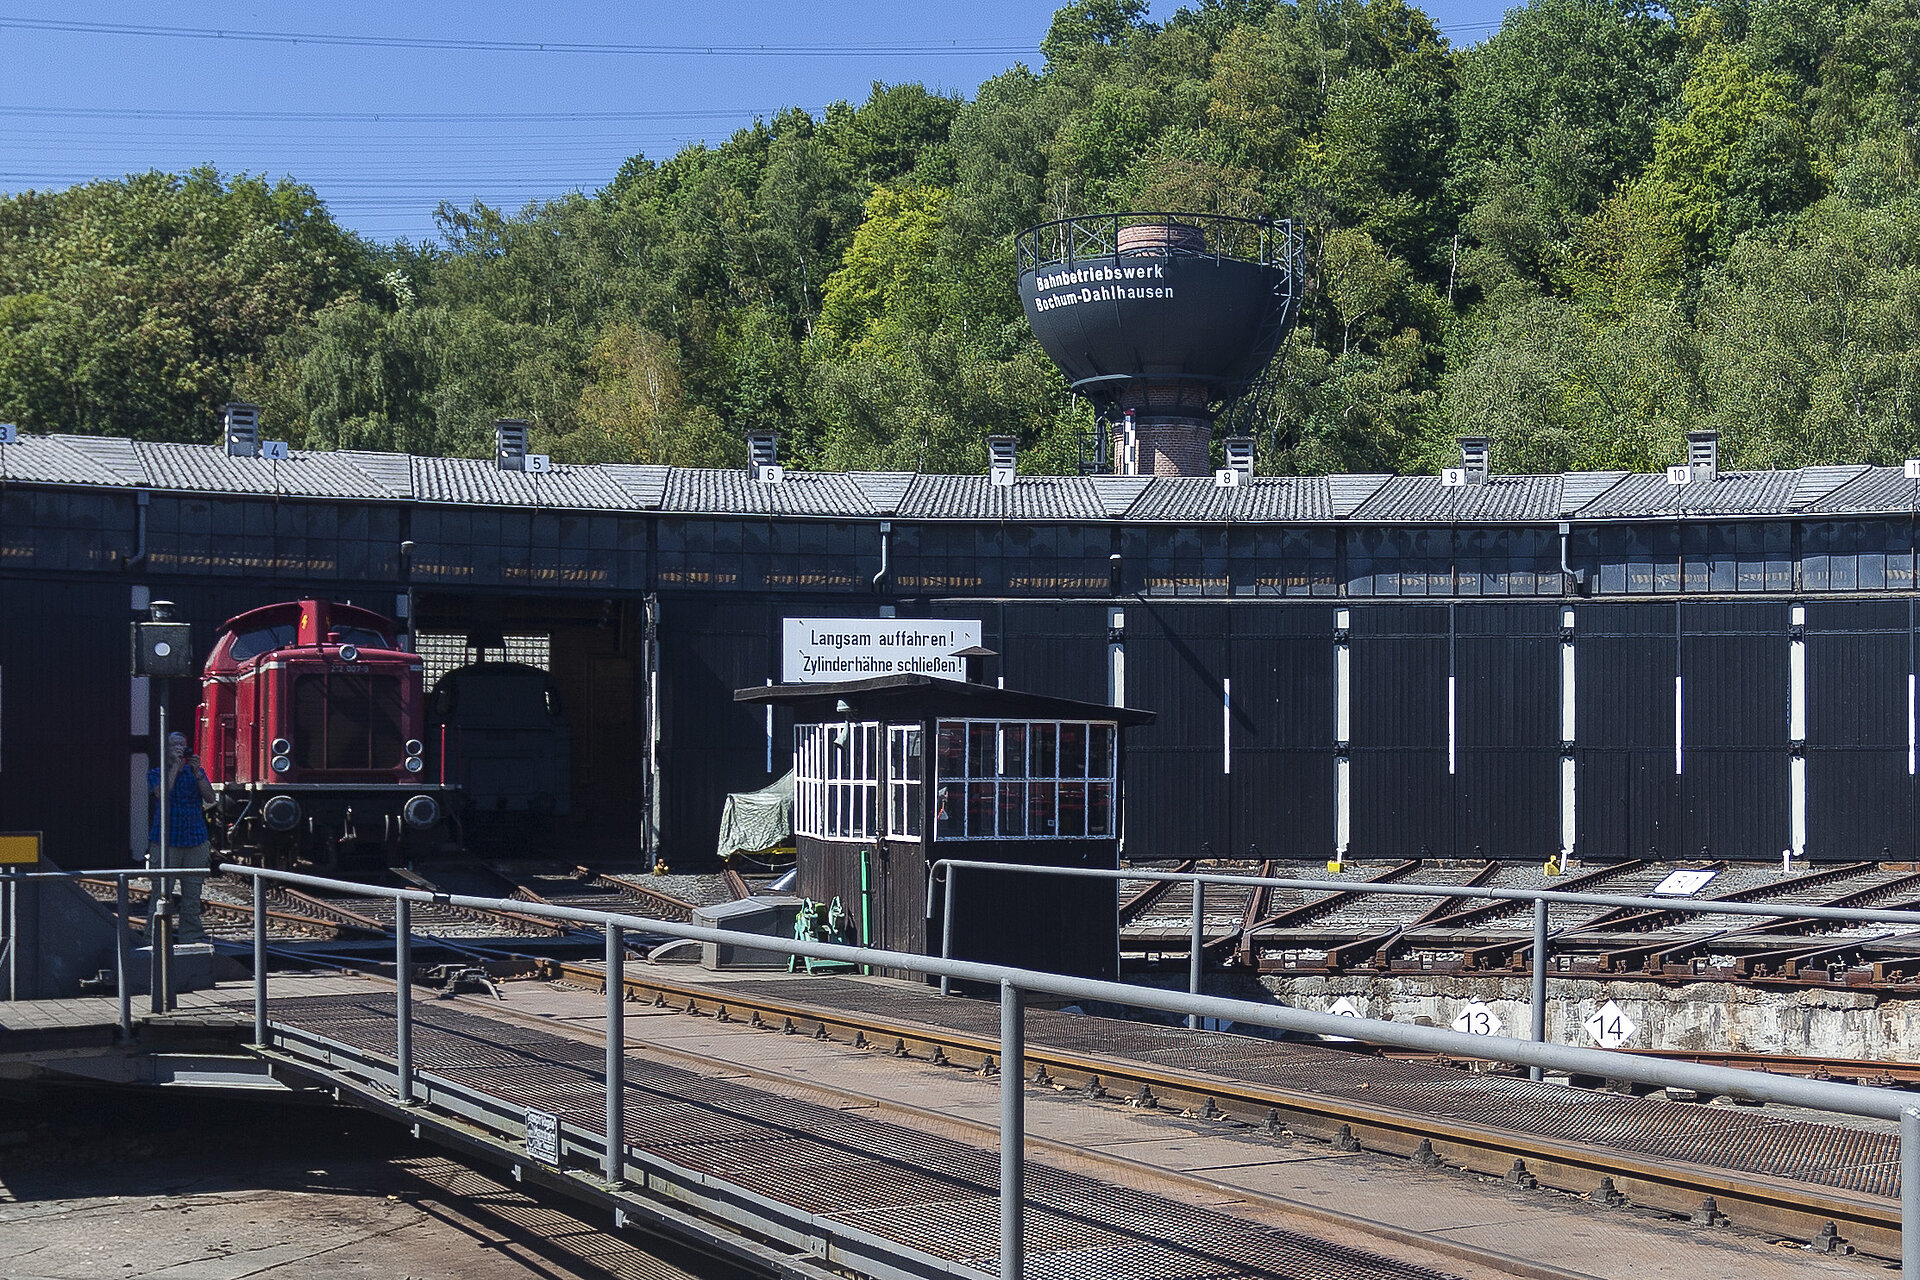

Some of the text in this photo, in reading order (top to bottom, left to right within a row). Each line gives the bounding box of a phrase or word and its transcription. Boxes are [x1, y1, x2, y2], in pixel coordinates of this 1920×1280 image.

[1036, 264, 1164, 292] Bahnbetriebswerk
[1034, 285, 1174, 312] Bochum-Dahlhausen
[0, 426, 8, 437] 3
[271, 443, 280, 456] 4
[533, 457, 542, 470] 5
[767, 468, 775, 481] 6
[998, 471, 1006, 483] 7
[1223, 472, 1231, 484] 8
[1450, 471, 1458, 484] 9
[1673, 469, 1686, 481] 10
[811, 629, 871, 649] Langsam
[803, 656, 963, 676] Zylinderhähne schließen!
[1459, 1012, 1490, 1036] 13
[1592, 1015, 1624, 1040] 14
